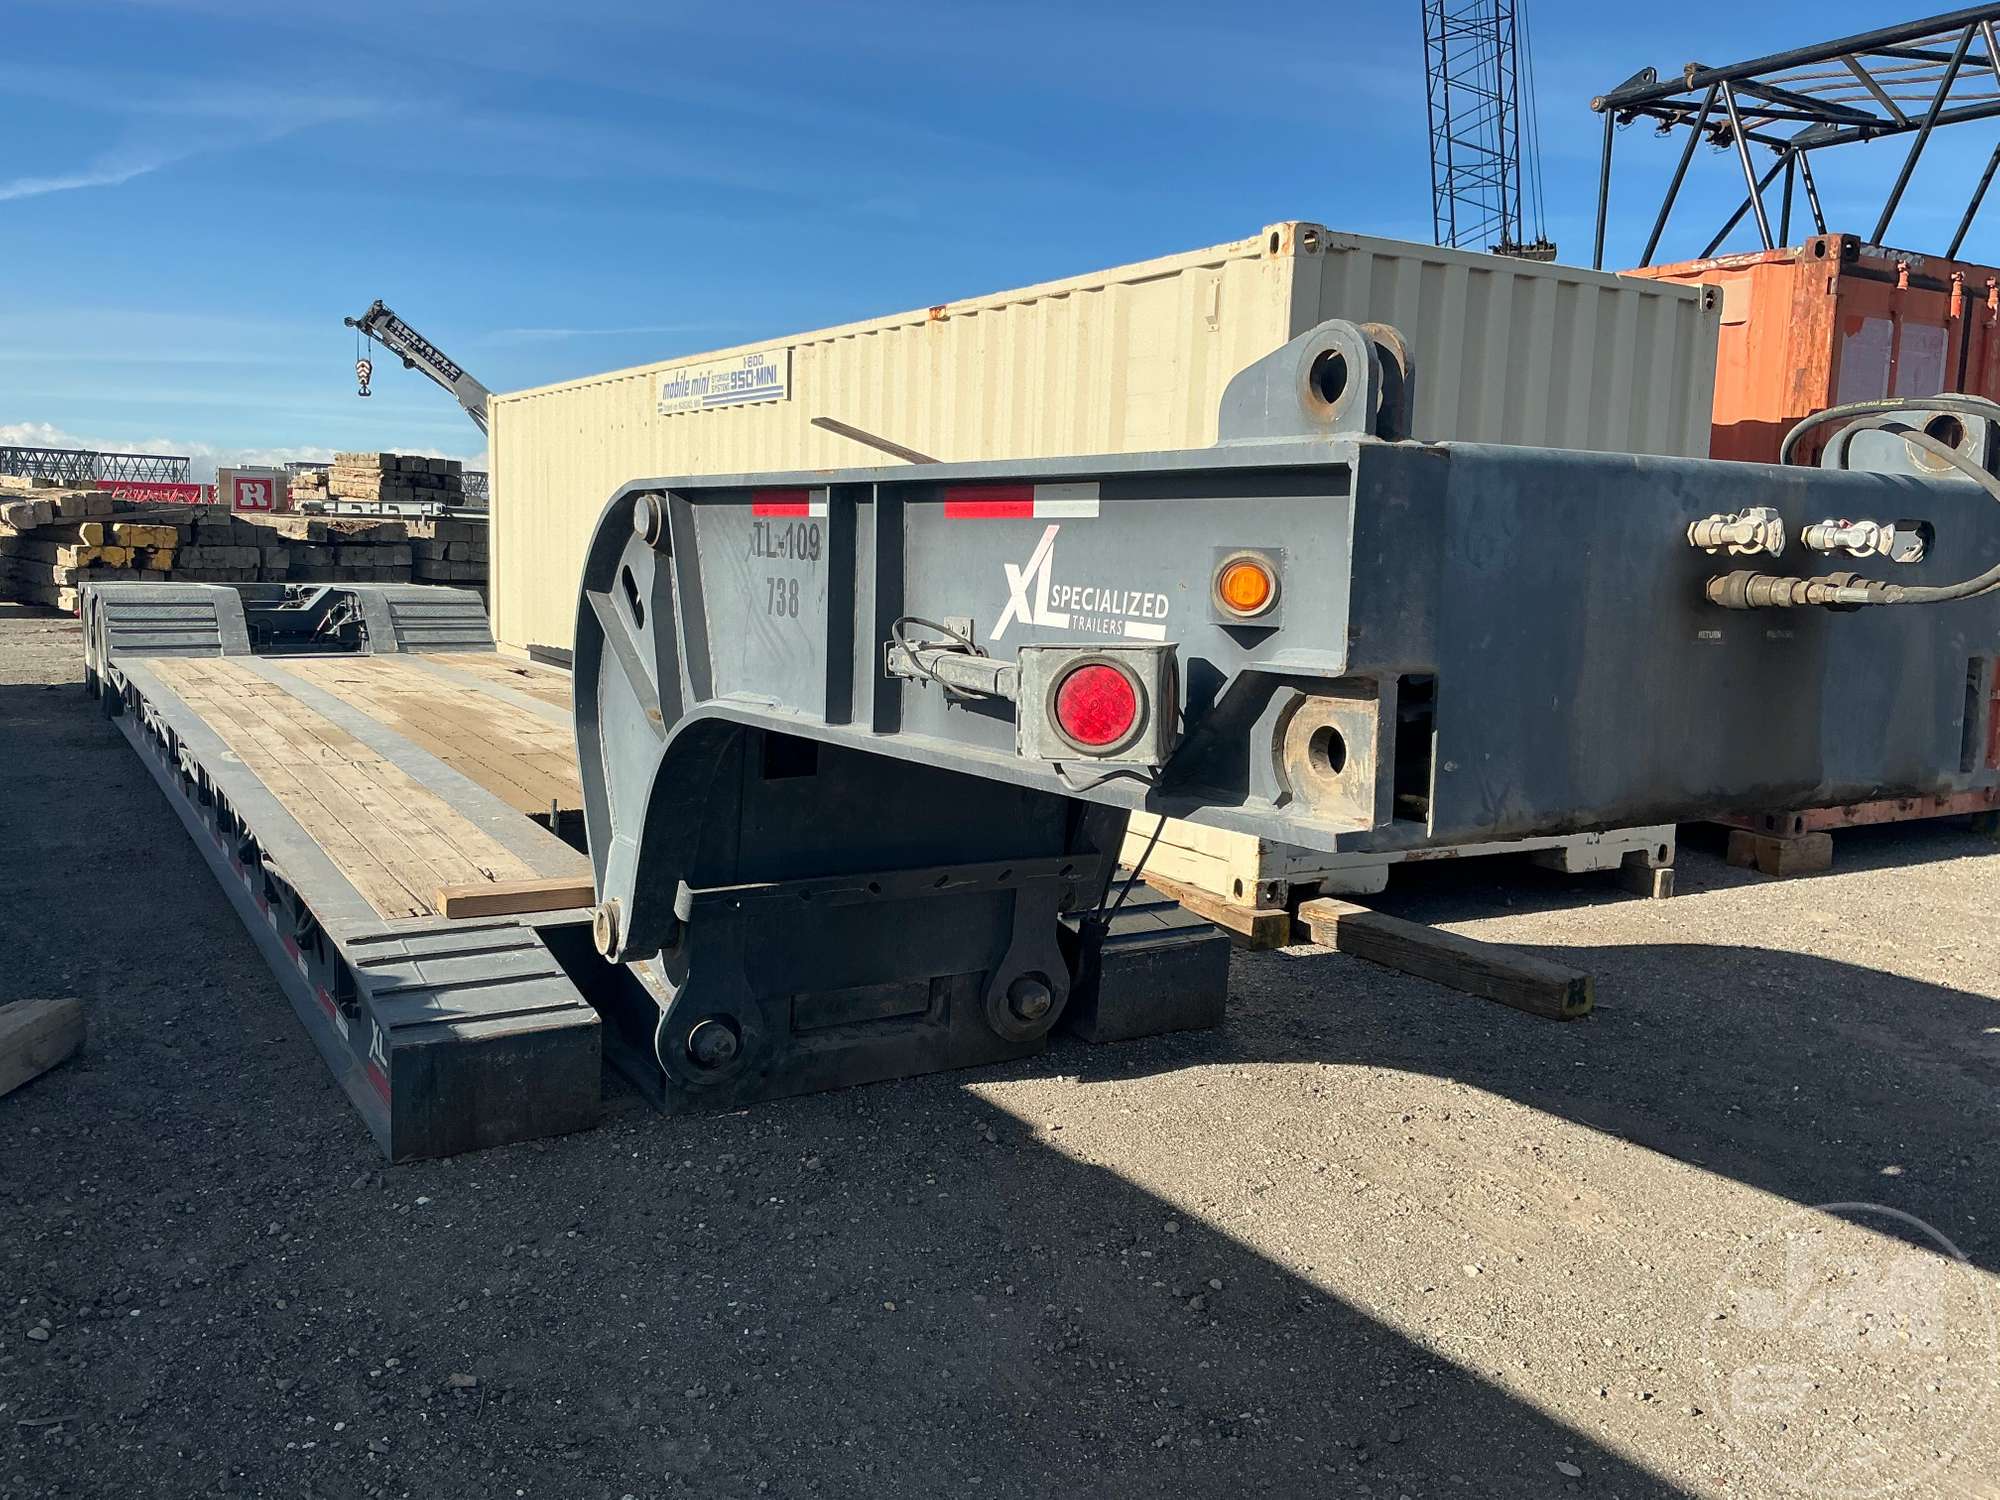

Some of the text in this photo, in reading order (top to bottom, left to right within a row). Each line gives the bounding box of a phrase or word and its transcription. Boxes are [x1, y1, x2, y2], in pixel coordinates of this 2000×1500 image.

[663, 370, 711, 400] mobile mini
[753, 521, 821, 561] TL-109
[766, 577, 799, 618] 738
[990, 525, 1070, 641] XL
[1051, 585, 1169, 619] SPECIALIZED
[1072, 615, 1123, 635] TRAILERS
